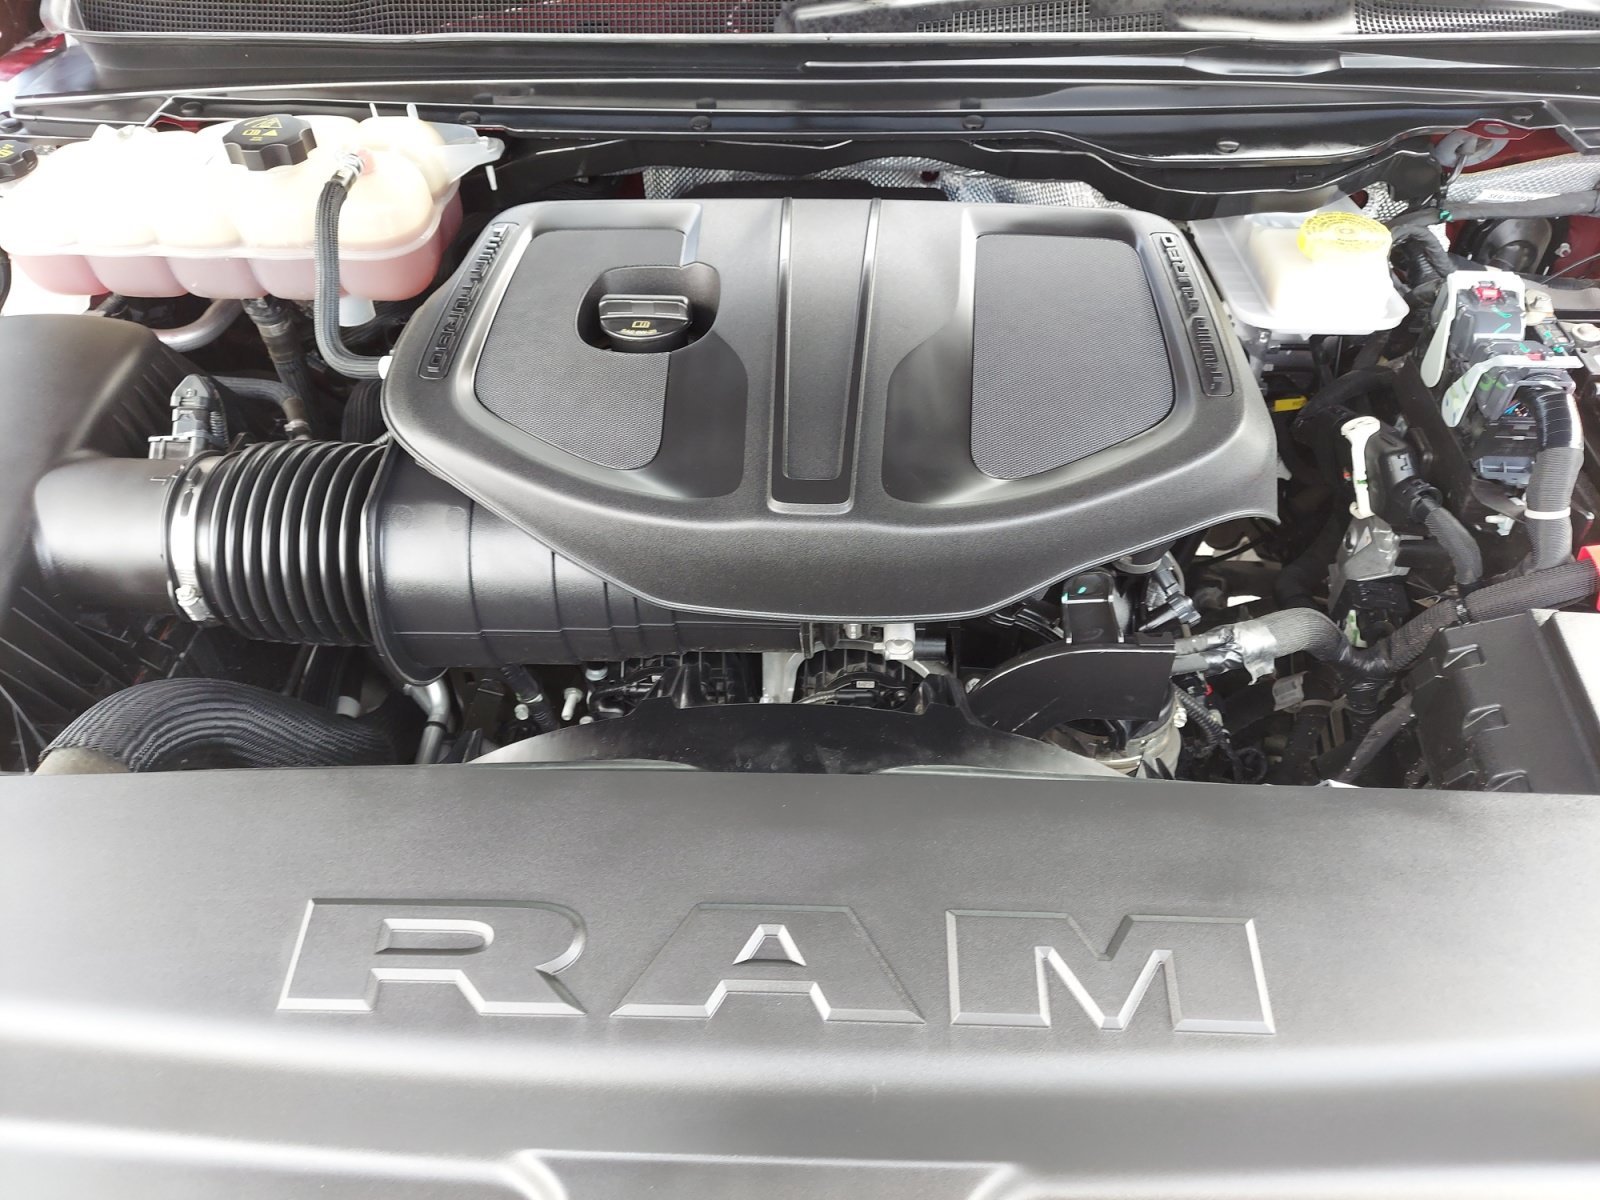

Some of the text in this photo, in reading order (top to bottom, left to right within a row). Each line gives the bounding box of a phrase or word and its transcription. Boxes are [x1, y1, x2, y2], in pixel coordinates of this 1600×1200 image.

[1160, 235, 1201, 315] TURBO
[427, 279, 480, 375] TURBO
[276, 898, 1276, 1035] RAM
